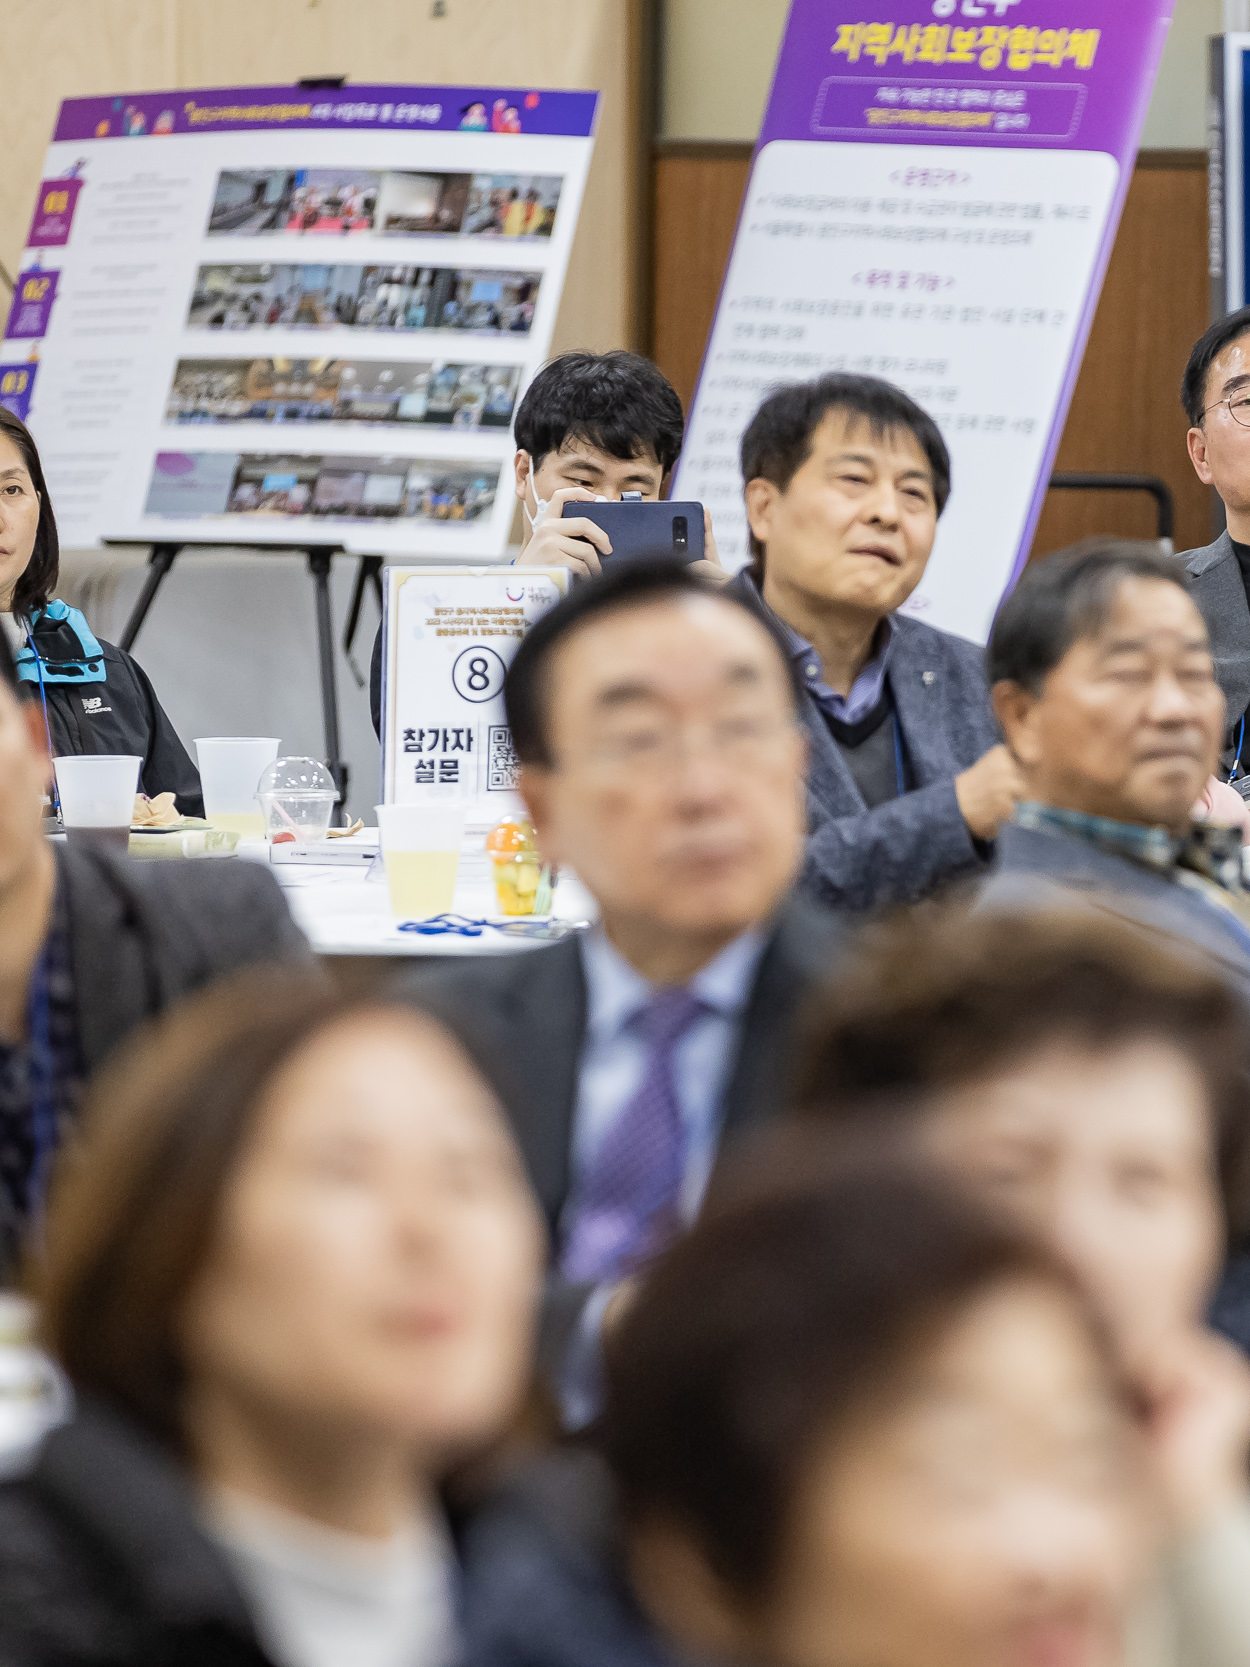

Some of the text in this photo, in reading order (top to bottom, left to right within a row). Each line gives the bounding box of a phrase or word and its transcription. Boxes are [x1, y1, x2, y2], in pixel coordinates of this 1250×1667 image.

[831, 22, 1101, 71] 지역사회보장협의체
[22, 276, 51, 303] 02
[403, 727, 473, 753] 참가자
[414, 758, 460, 784] 설문
